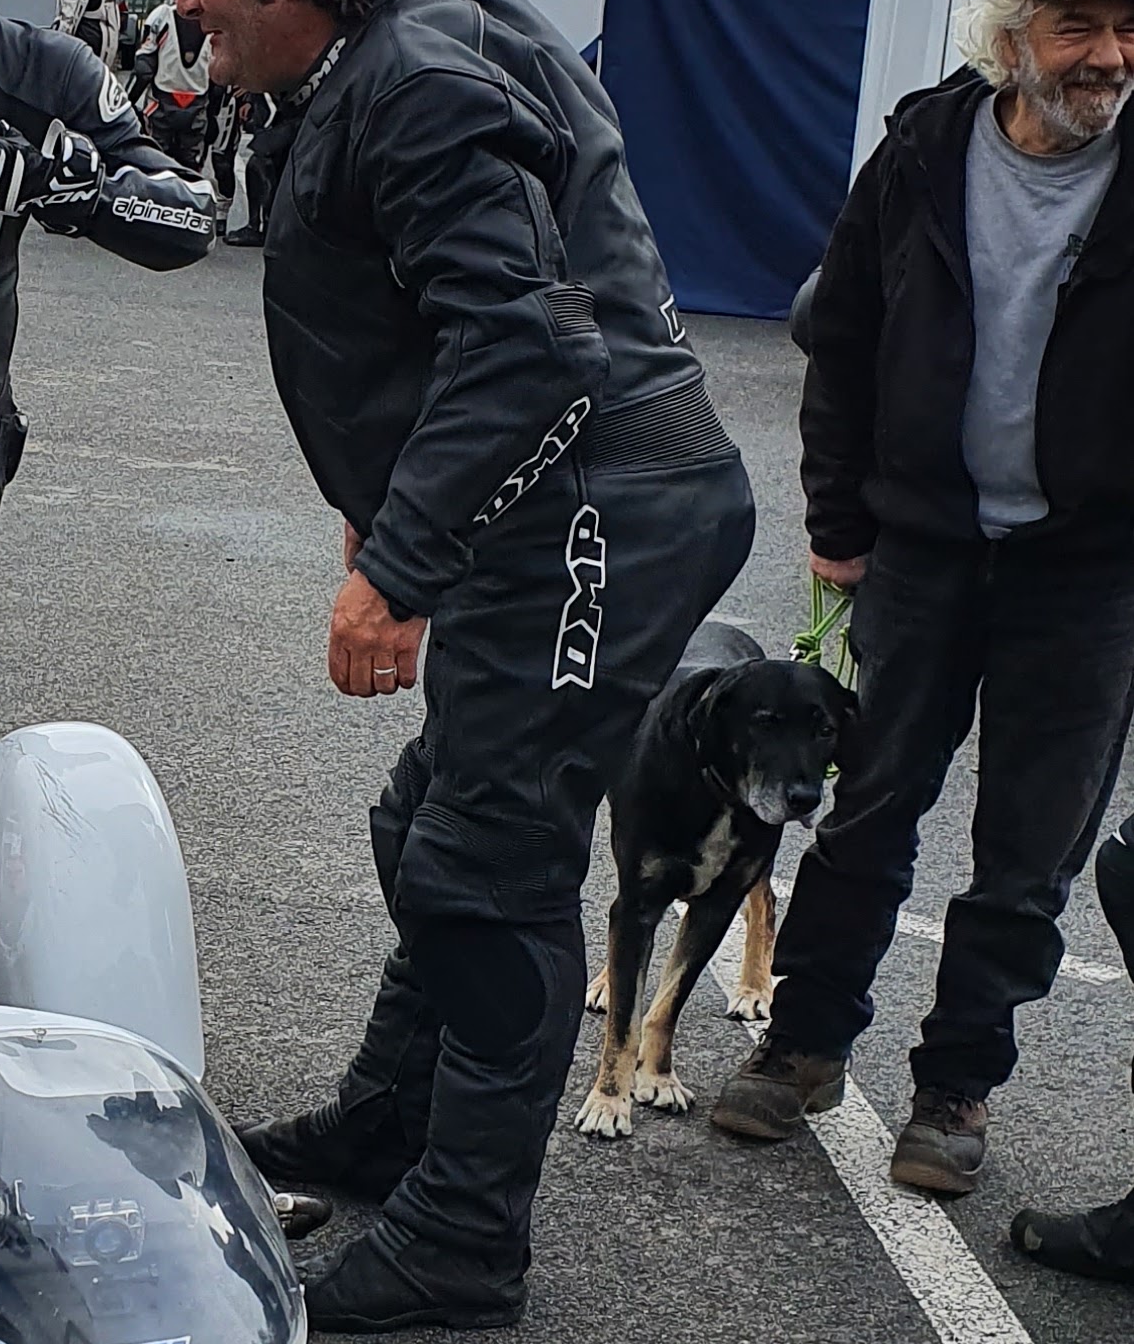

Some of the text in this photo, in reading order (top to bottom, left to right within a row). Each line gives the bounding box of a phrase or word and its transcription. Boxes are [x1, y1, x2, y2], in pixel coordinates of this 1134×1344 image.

[287, 36, 347, 106] DMP
[112, 195, 214, 234] alpinestars
[473, 396, 591, 525] DMP
[551, 503, 606, 690] DMP
